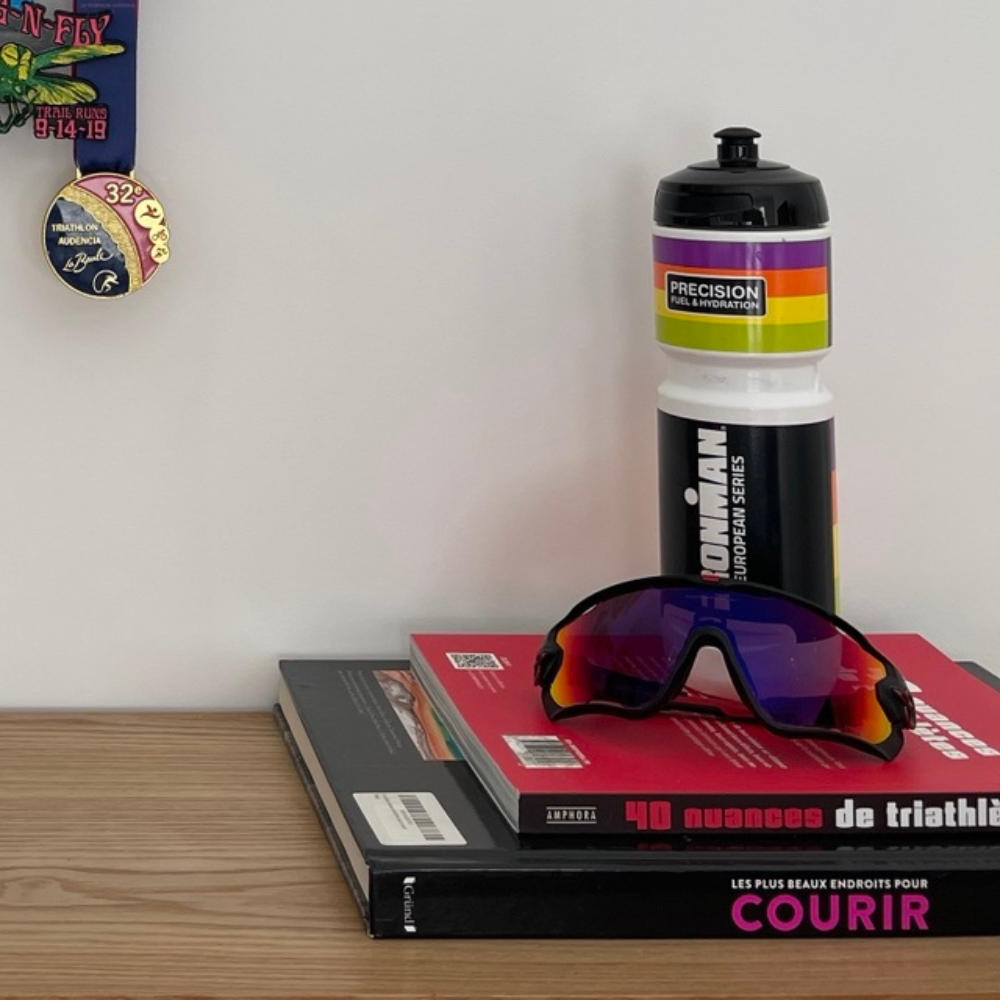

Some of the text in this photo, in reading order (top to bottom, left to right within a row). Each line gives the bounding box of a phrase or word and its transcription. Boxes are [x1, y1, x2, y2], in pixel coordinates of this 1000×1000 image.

[36, 105, 108, 119] TRAIL RUNS
[34, 119, 107, 139] 9-14-19
[51, 223, 98, 232] TRIATHLON
[58, 237, 101, 245] AUDENCIA
[670, 280, 759, 299] PRECISION
[670, 296, 760, 310] FUEL & HYDRATION
[731, 455, 745, 505] SERIES
[546, 809, 597, 821] AMPHORA
[625, 797, 1000, 831] 40 nuances de triathlè
[731, 879, 928, 889] LES PLUS BEAUX ENDROITS POUR
[404, 884, 415, 925] Gründ
[731, 894, 930, 932] COURIR
